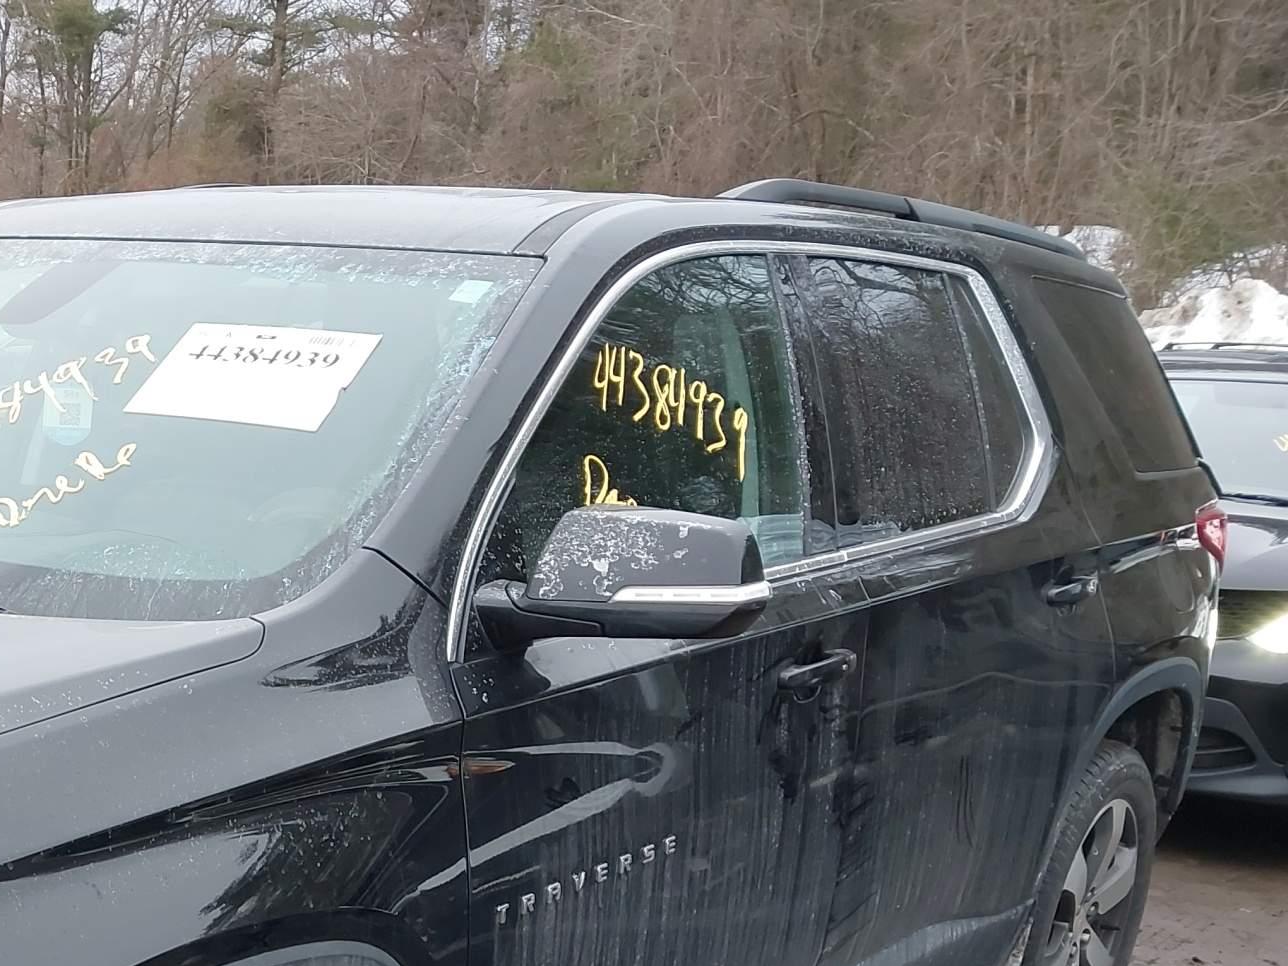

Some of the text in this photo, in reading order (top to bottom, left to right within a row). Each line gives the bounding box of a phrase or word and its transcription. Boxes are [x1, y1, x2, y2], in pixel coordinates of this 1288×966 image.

[189, 344, 340, 368] 44384939
[594, 342, 748, 483] 44384939
[497, 835, 676, 925] TRAVERSE
